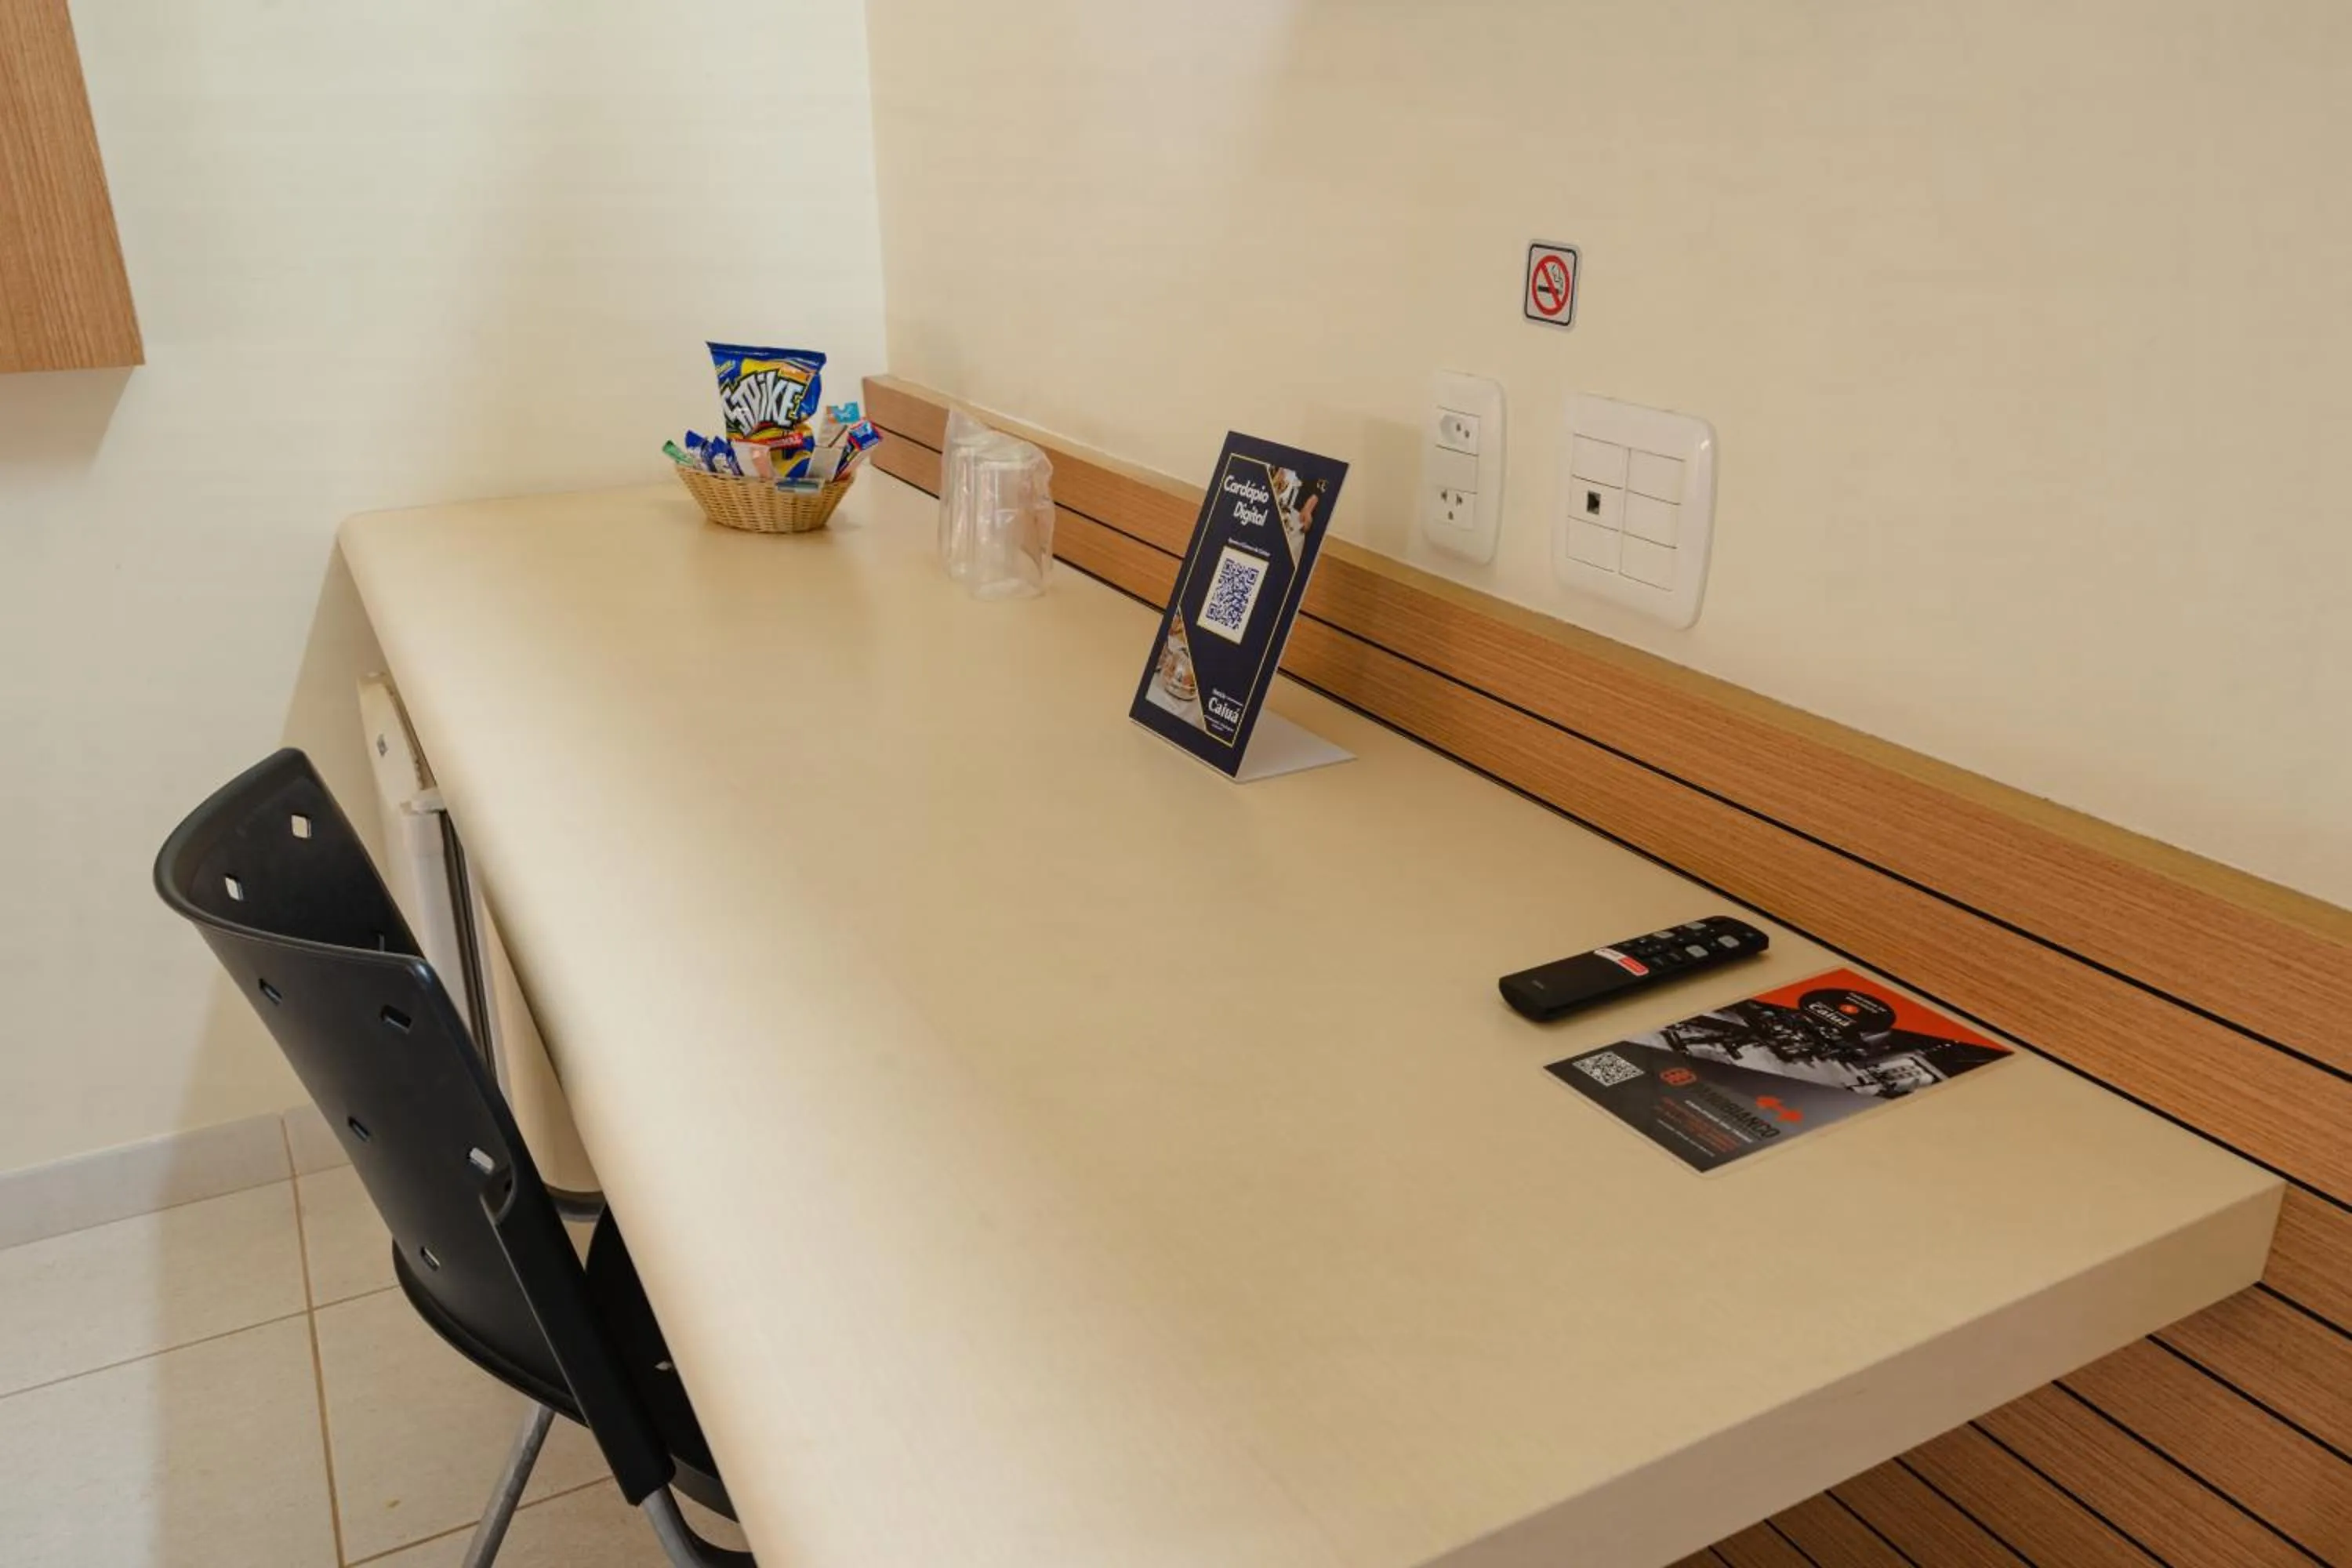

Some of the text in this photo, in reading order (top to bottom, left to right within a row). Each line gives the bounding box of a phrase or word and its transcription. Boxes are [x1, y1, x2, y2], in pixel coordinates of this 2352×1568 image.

[1224, 475, 1269, 504] Cardápio
[1233, 501, 1269, 527] Digital
[1208, 697, 1240, 724] Caiuá
